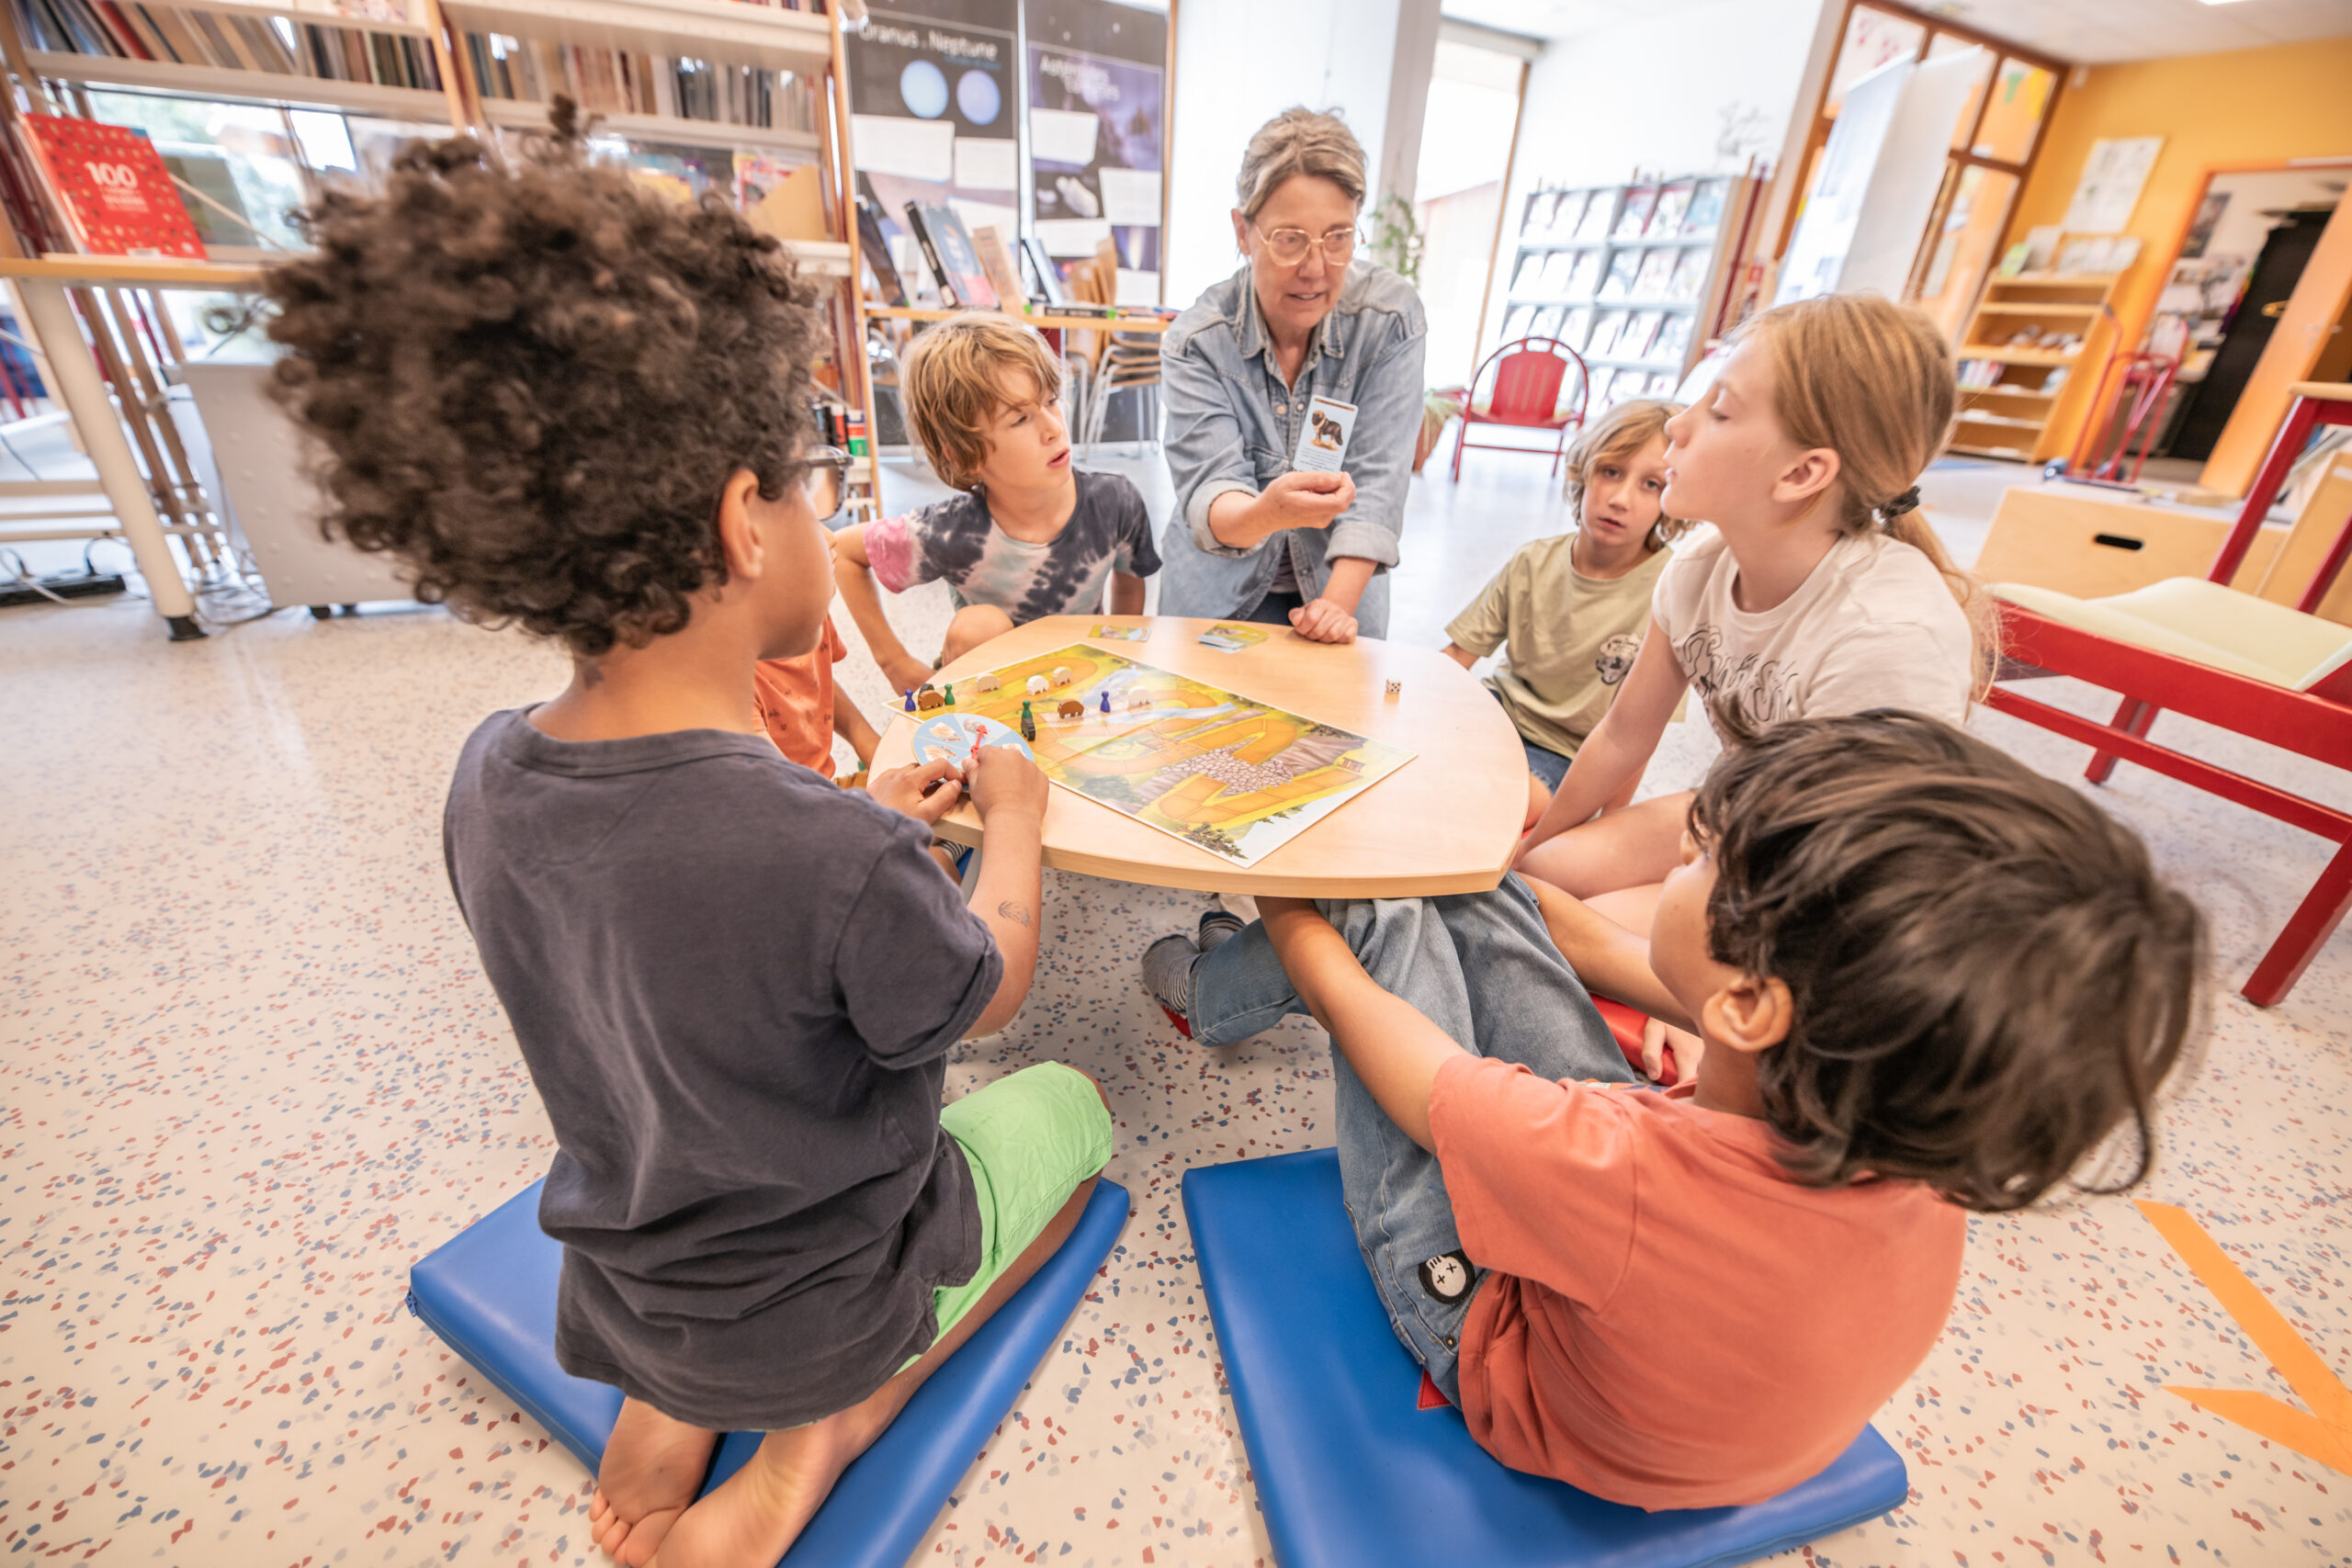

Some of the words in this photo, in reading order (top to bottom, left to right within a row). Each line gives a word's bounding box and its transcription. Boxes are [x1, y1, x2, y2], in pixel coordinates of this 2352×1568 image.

[859, 23, 919, 49] Uranus
[929, 29, 998, 62] Neptune
[84, 161, 138, 189] 100
